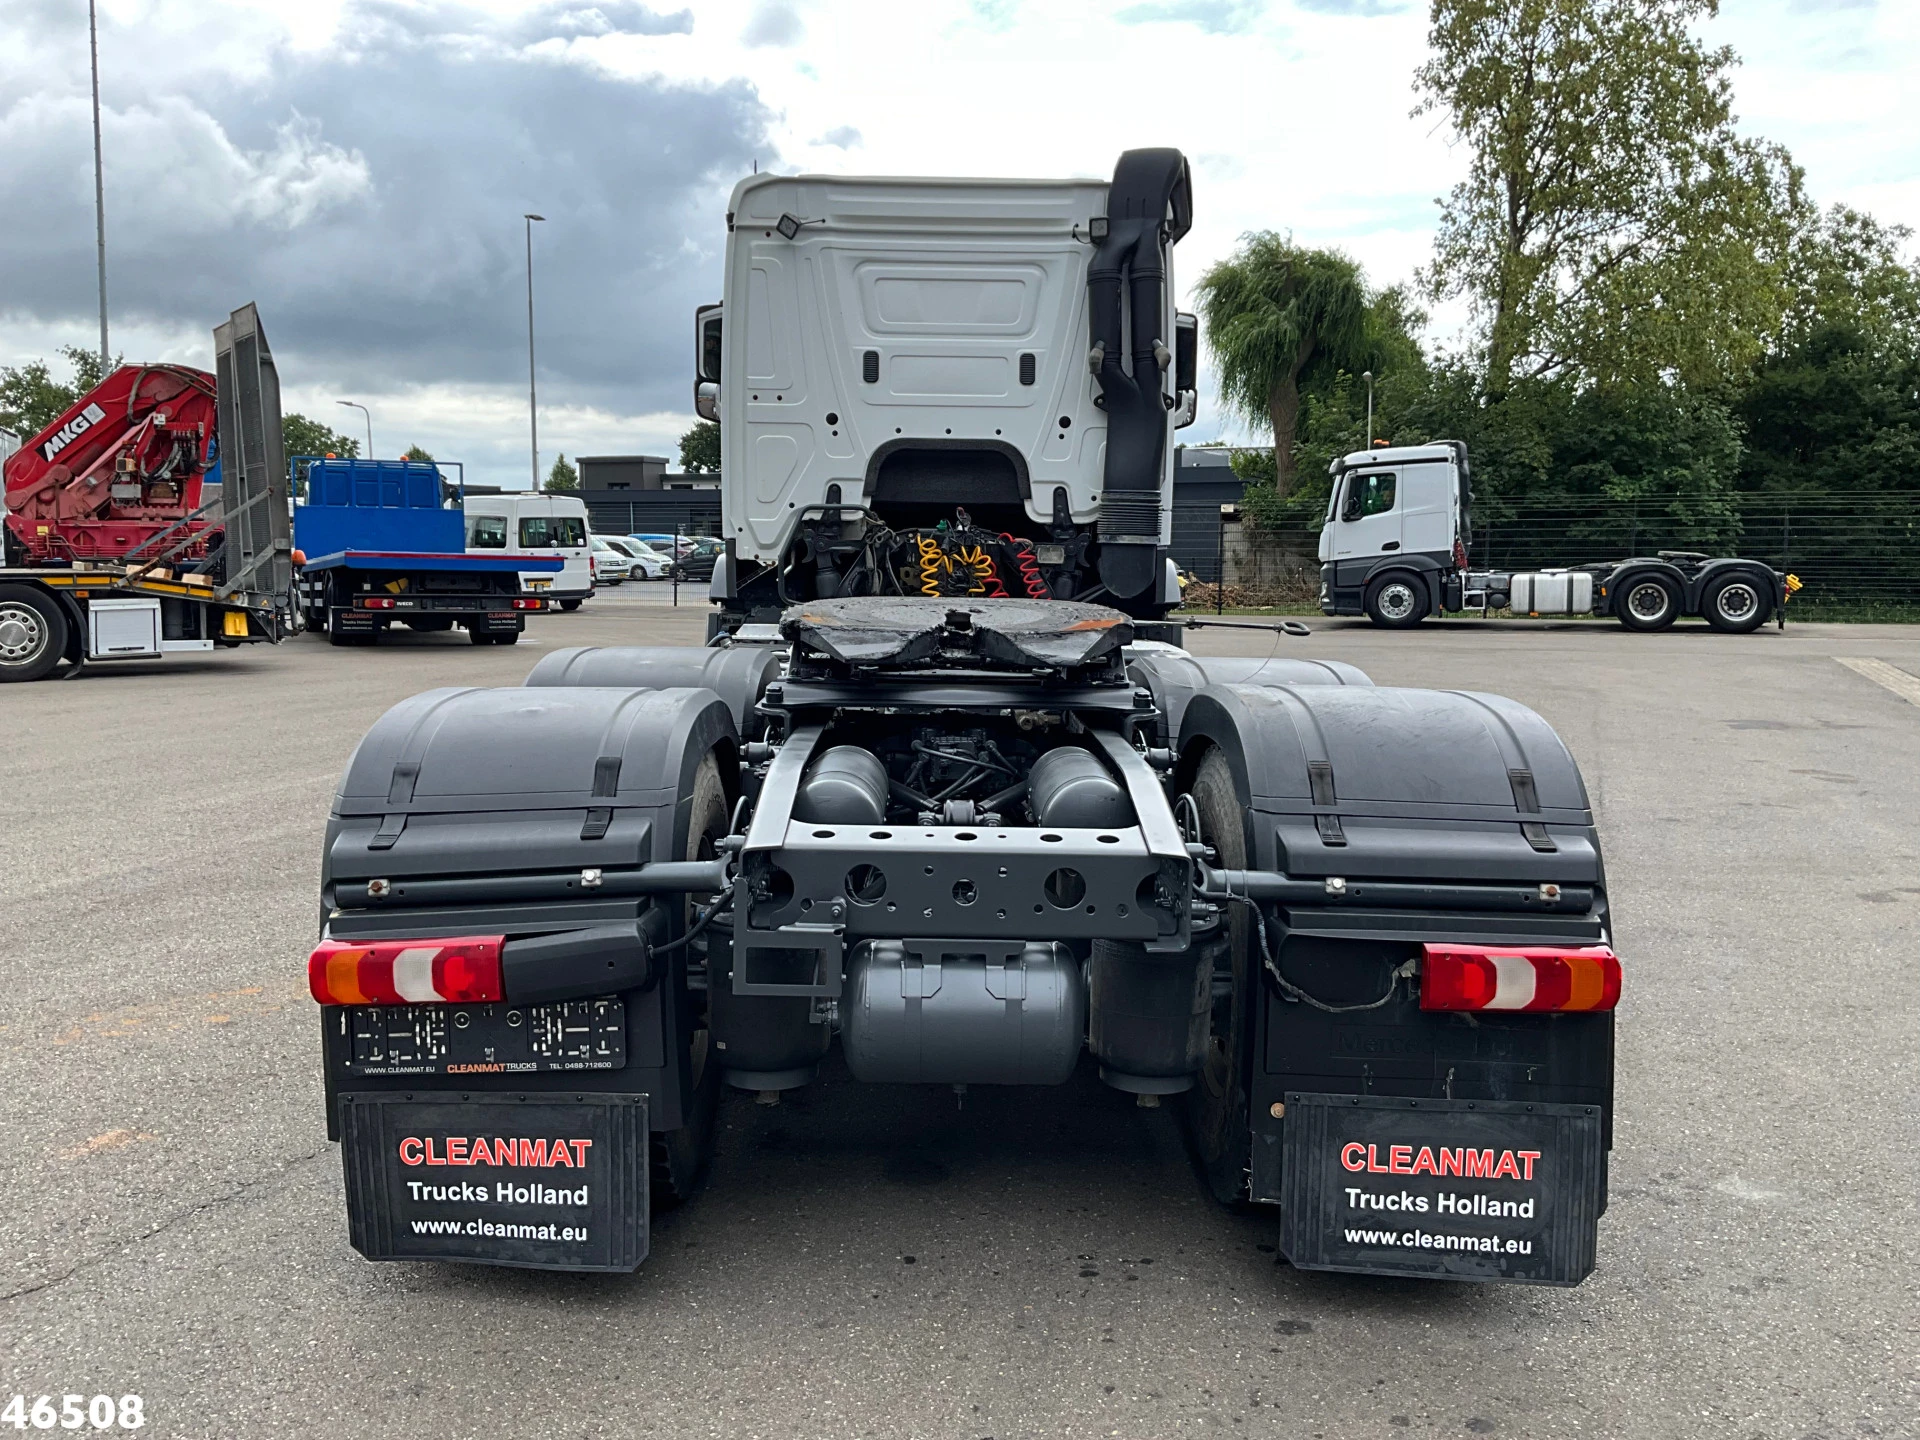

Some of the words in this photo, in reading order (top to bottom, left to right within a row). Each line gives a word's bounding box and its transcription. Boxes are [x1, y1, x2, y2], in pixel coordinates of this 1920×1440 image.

[44, 415, 91, 462] MKG
[364, 1066, 435, 1074] WWW.CLEANMAT.EU
[446, 1063, 506, 1073] CLEANMAT
[506, 1062, 537, 1070] TRUCKS
[399, 1136, 592, 1168] CLEANMAT
[1340, 1141, 1541, 1180] CLEANMAT
[407, 1181, 489, 1202] Trucks
[496, 1182, 588, 1206] Holland
[1344, 1187, 1429, 1213] Trucks
[1437, 1192, 1534, 1219] Holland
[411, 1218, 587, 1241] www.cleanmat.eu
[1344, 1228, 1532, 1255] www.cleanmat.eu
